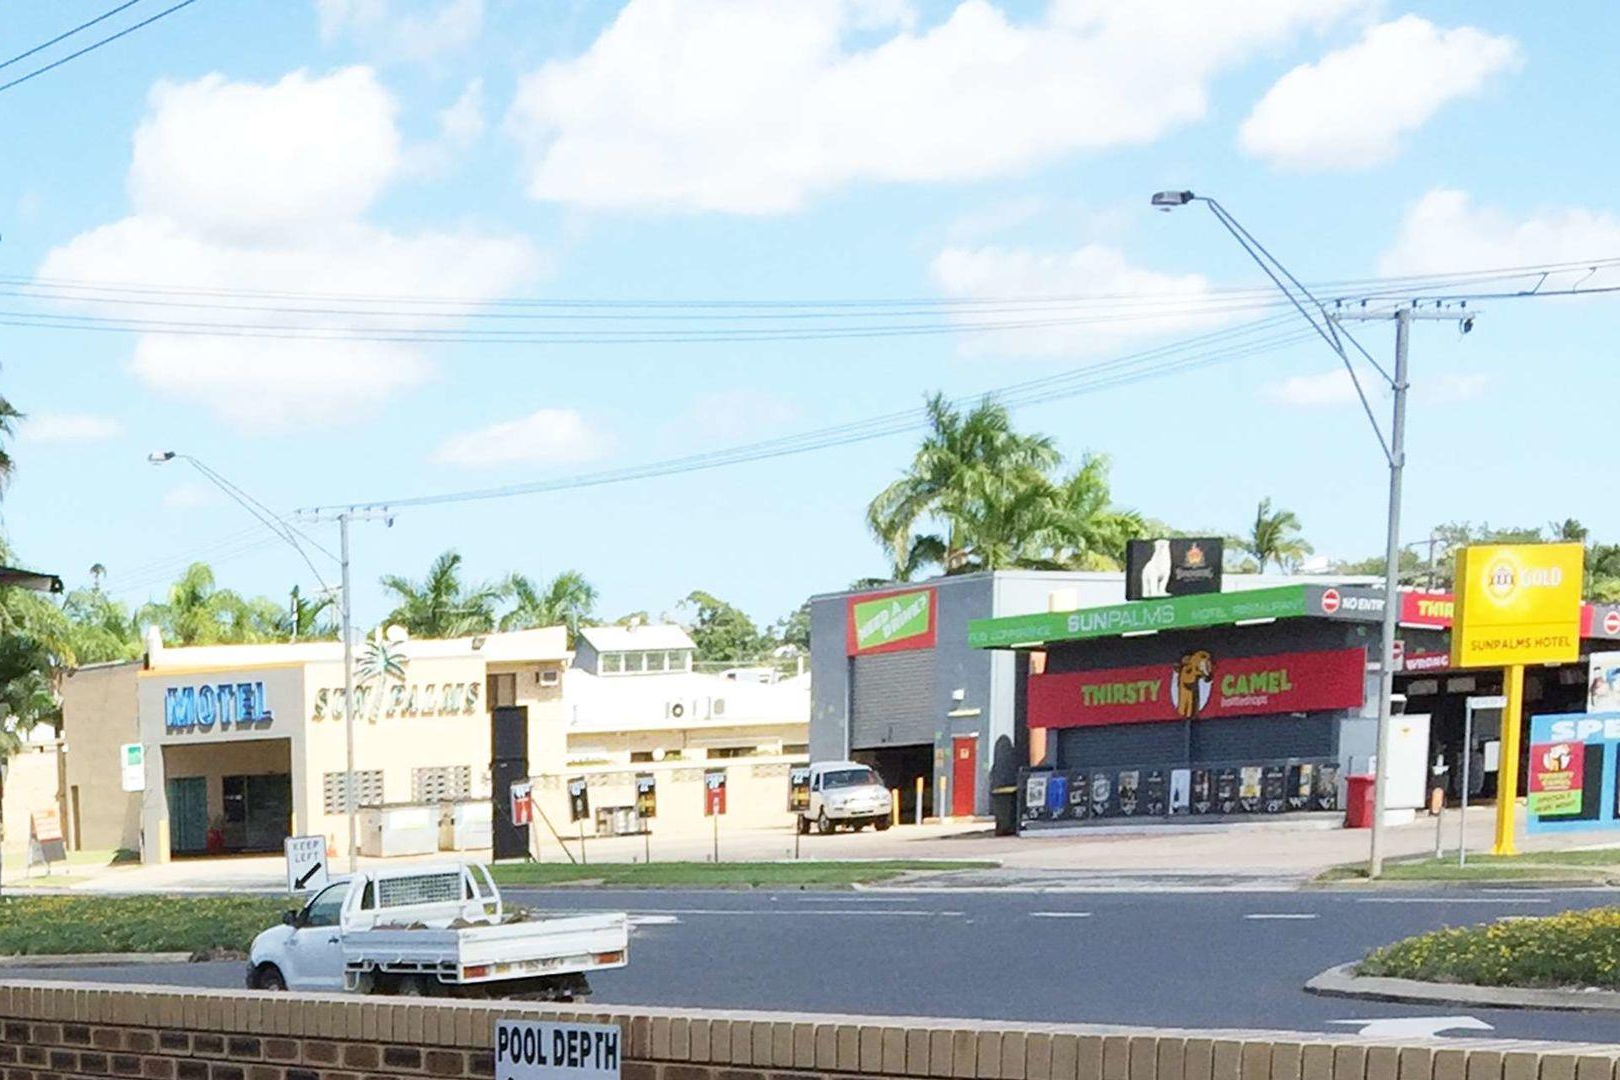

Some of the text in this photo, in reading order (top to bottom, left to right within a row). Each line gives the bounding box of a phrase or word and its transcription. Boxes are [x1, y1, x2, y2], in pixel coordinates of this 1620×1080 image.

[1067, 605, 1175, 632] SUNPALMS
[1418, 600, 1455, 618] THIR
[1471, 635, 1571, 651] SUNPALMS HOTEL
[1082, 680, 1161, 706] THIRSTY
[1221, 669, 1292, 697] CAMEL
[165, 681, 272, 728] MOTEL
[386, 682, 481, 719] PALMS
[293, 840, 319, 851] KEEP
[295, 852, 319, 863] LEFT
[498, 1026, 617, 1070] POOL DEPTH
